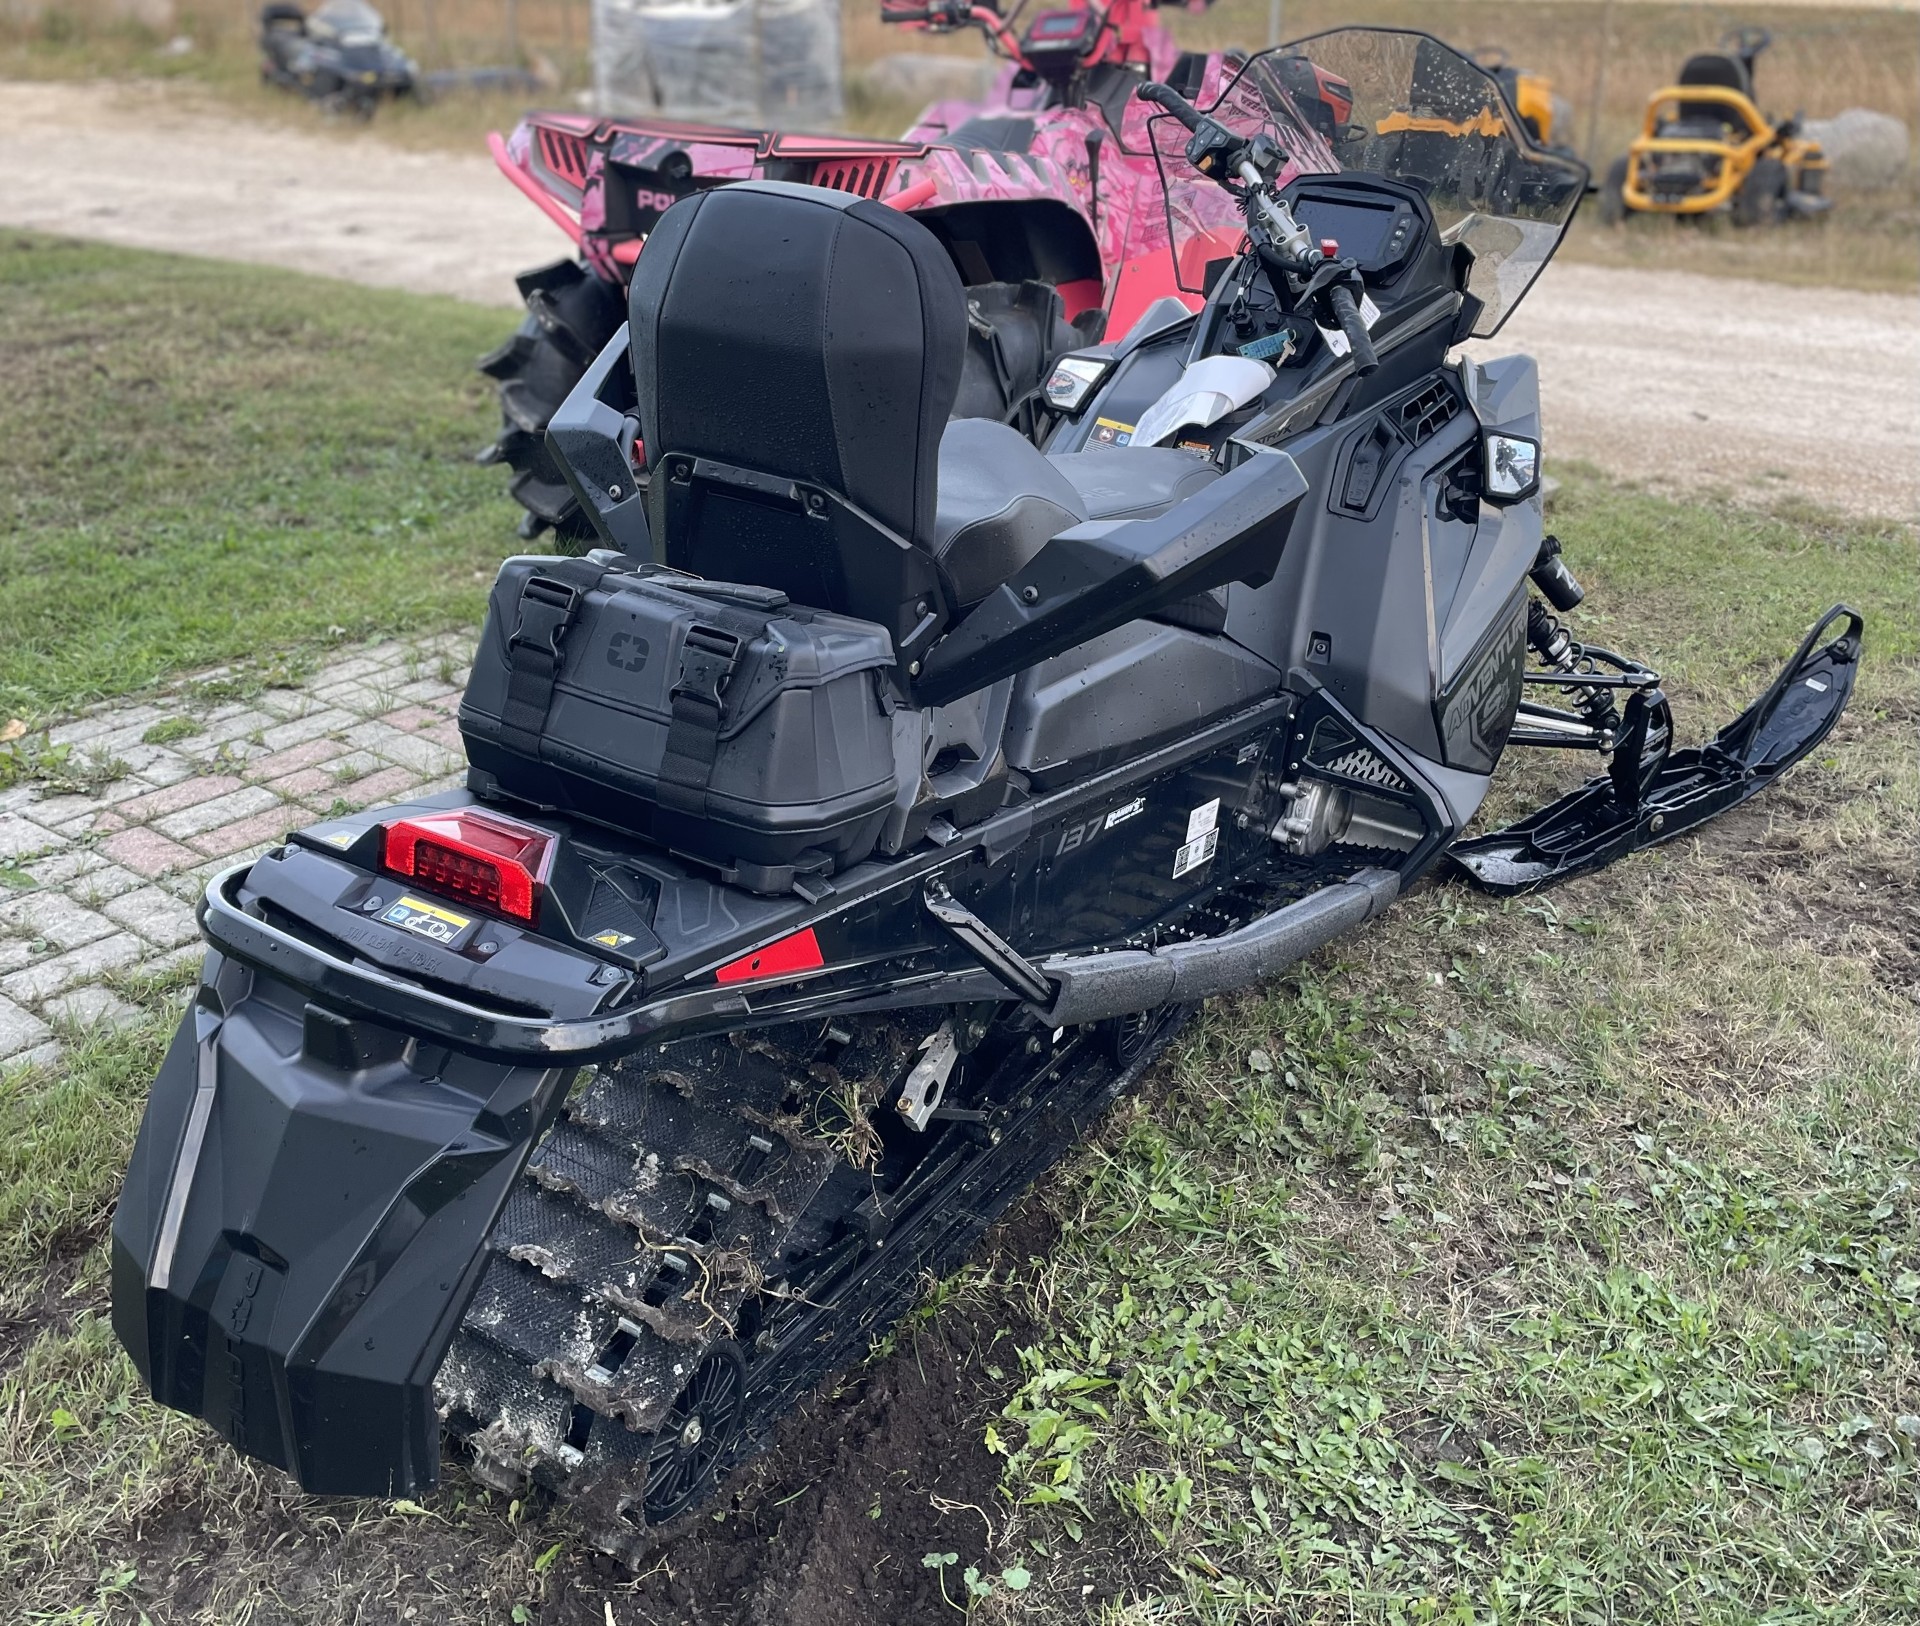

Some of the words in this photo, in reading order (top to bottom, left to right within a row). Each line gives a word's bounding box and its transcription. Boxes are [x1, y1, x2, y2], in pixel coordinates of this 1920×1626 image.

[1447, 606, 1528, 741] ADVENTUR
[1056, 815, 1105, 856] 137
[344, 926, 369, 941] STAY
[366, 934, 393, 953] CLEAR
[393, 945, 410, 957] OF
[409, 951, 441, 973] TRACK
